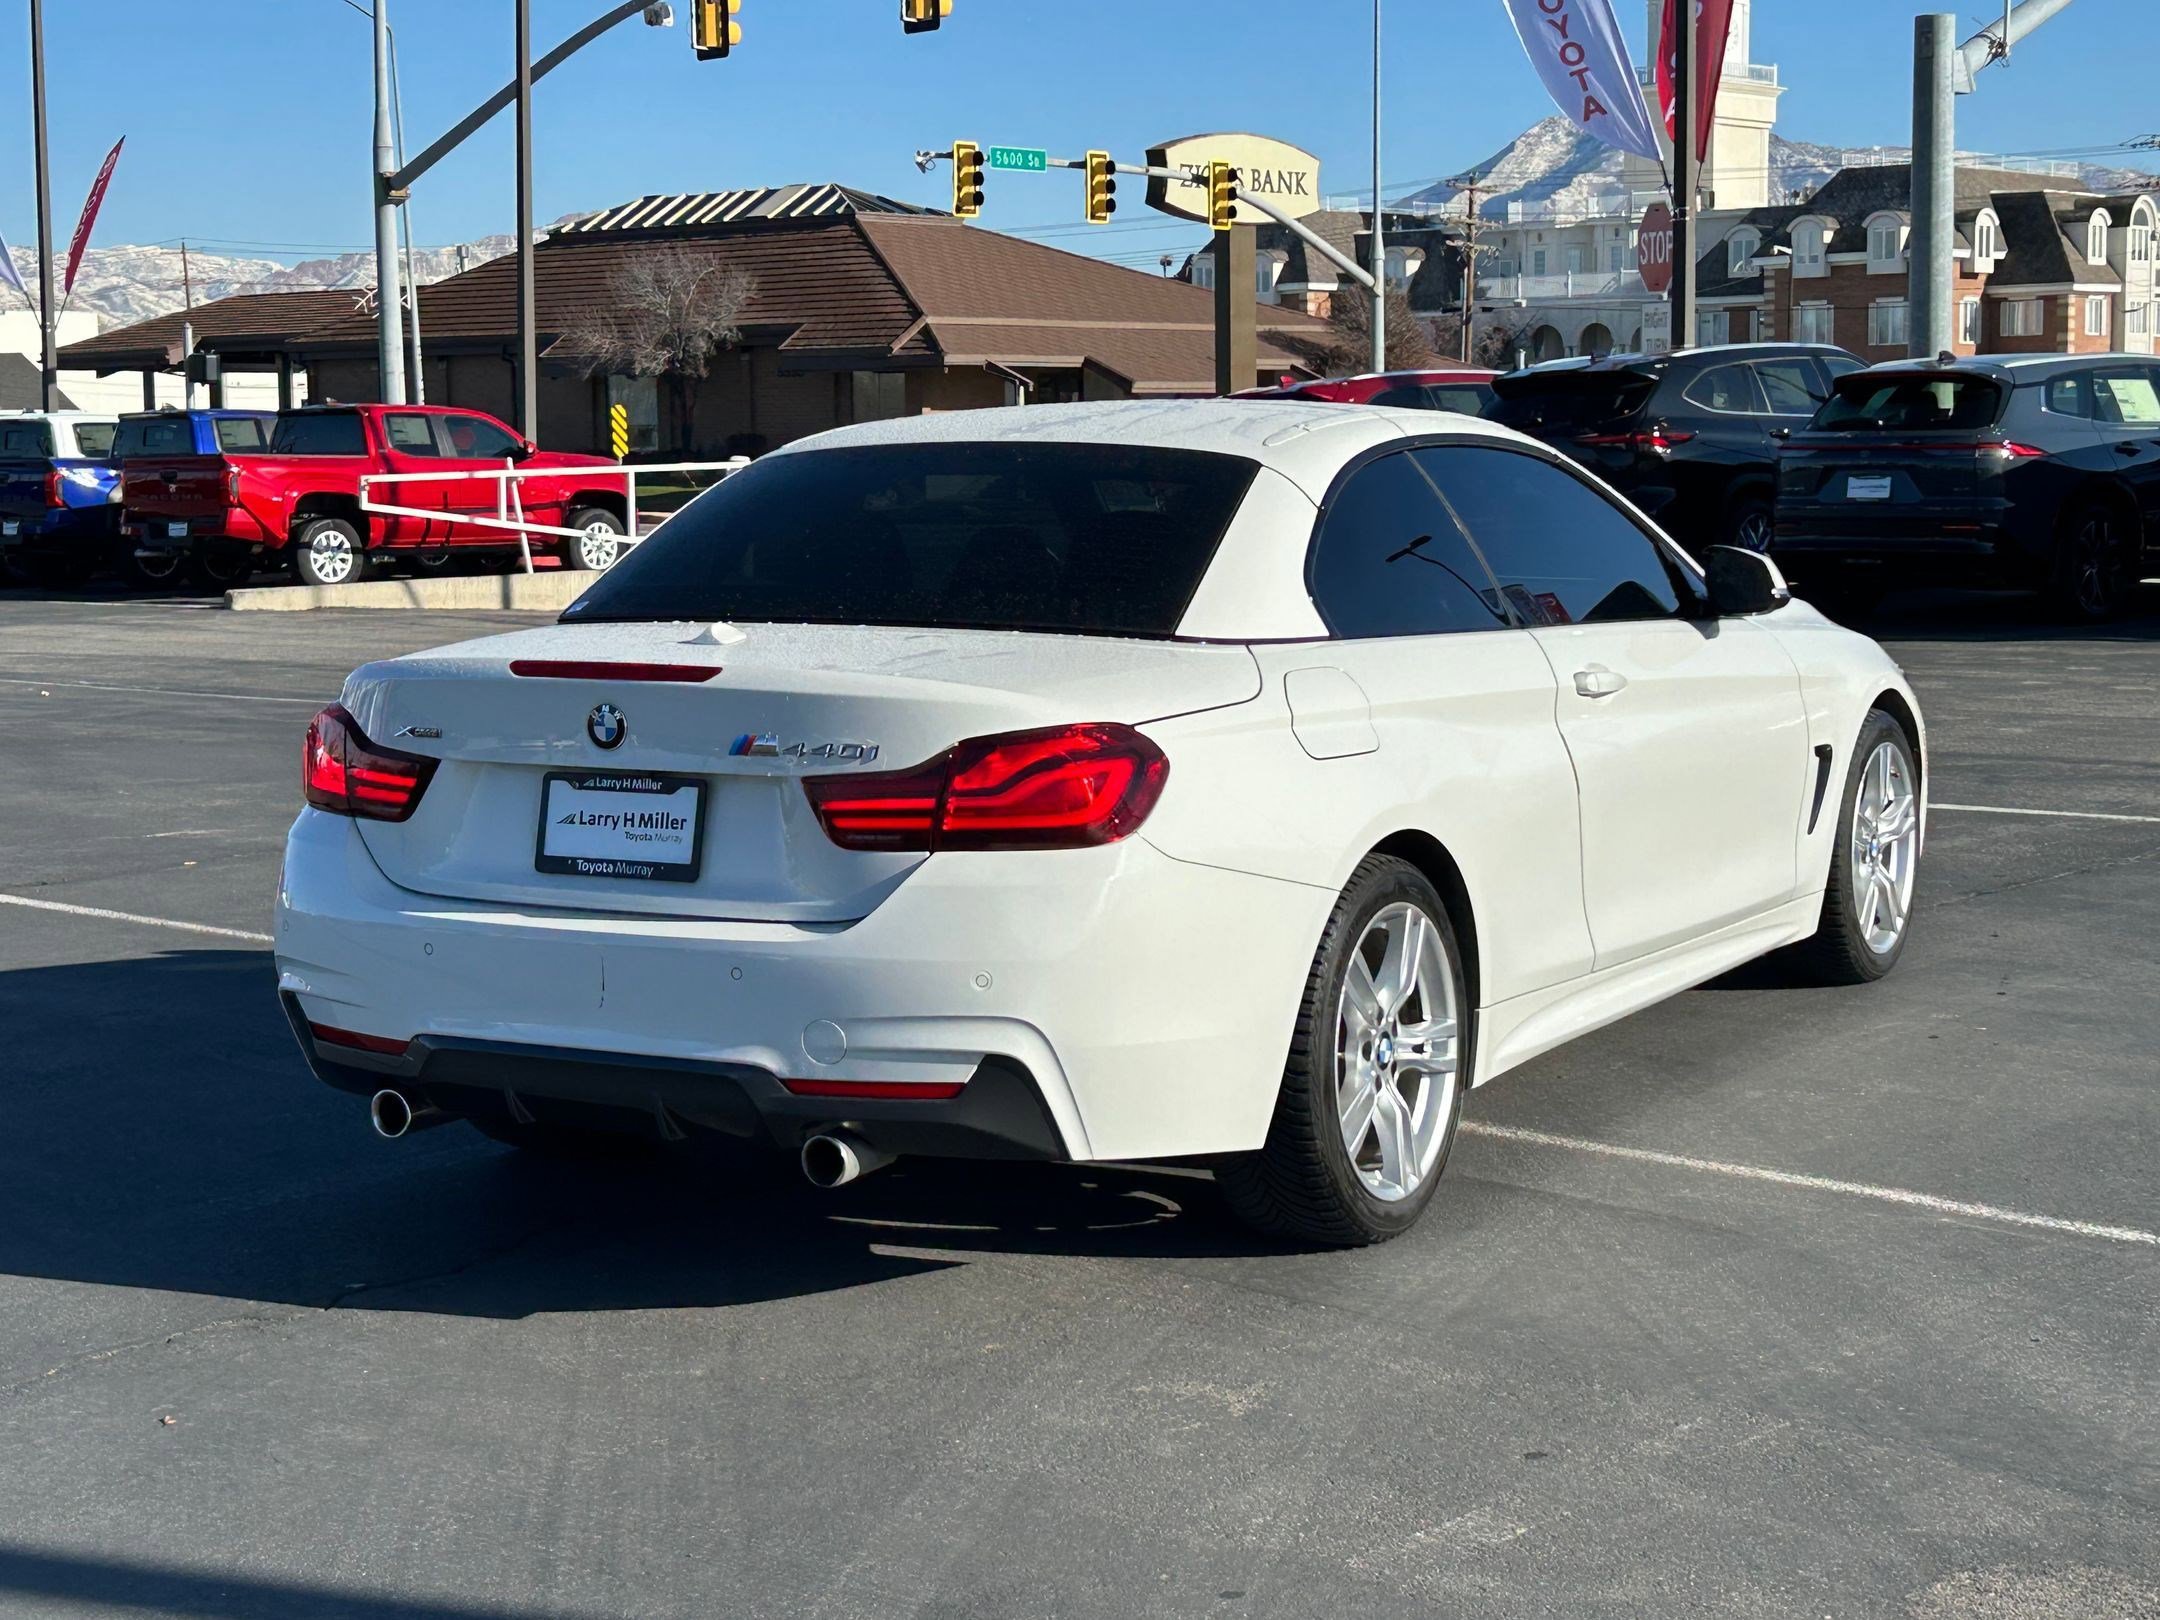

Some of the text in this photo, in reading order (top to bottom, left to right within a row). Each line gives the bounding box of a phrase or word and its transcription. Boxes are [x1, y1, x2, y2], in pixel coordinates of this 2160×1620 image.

[996, 150, 1023, 166] 5600
[1251, 168, 1308, 195] BANK
[1640, 230, 1673, 264] STOP
[591, 704, 623, 720] BMW
[596, 777, 662, 790] Larry H Miller
[579, 810, 687, 830] Larry H Miller
[624, 831, 683, 845] Toyota Murray
[576, 859, 654, 877] Toyota Murray
